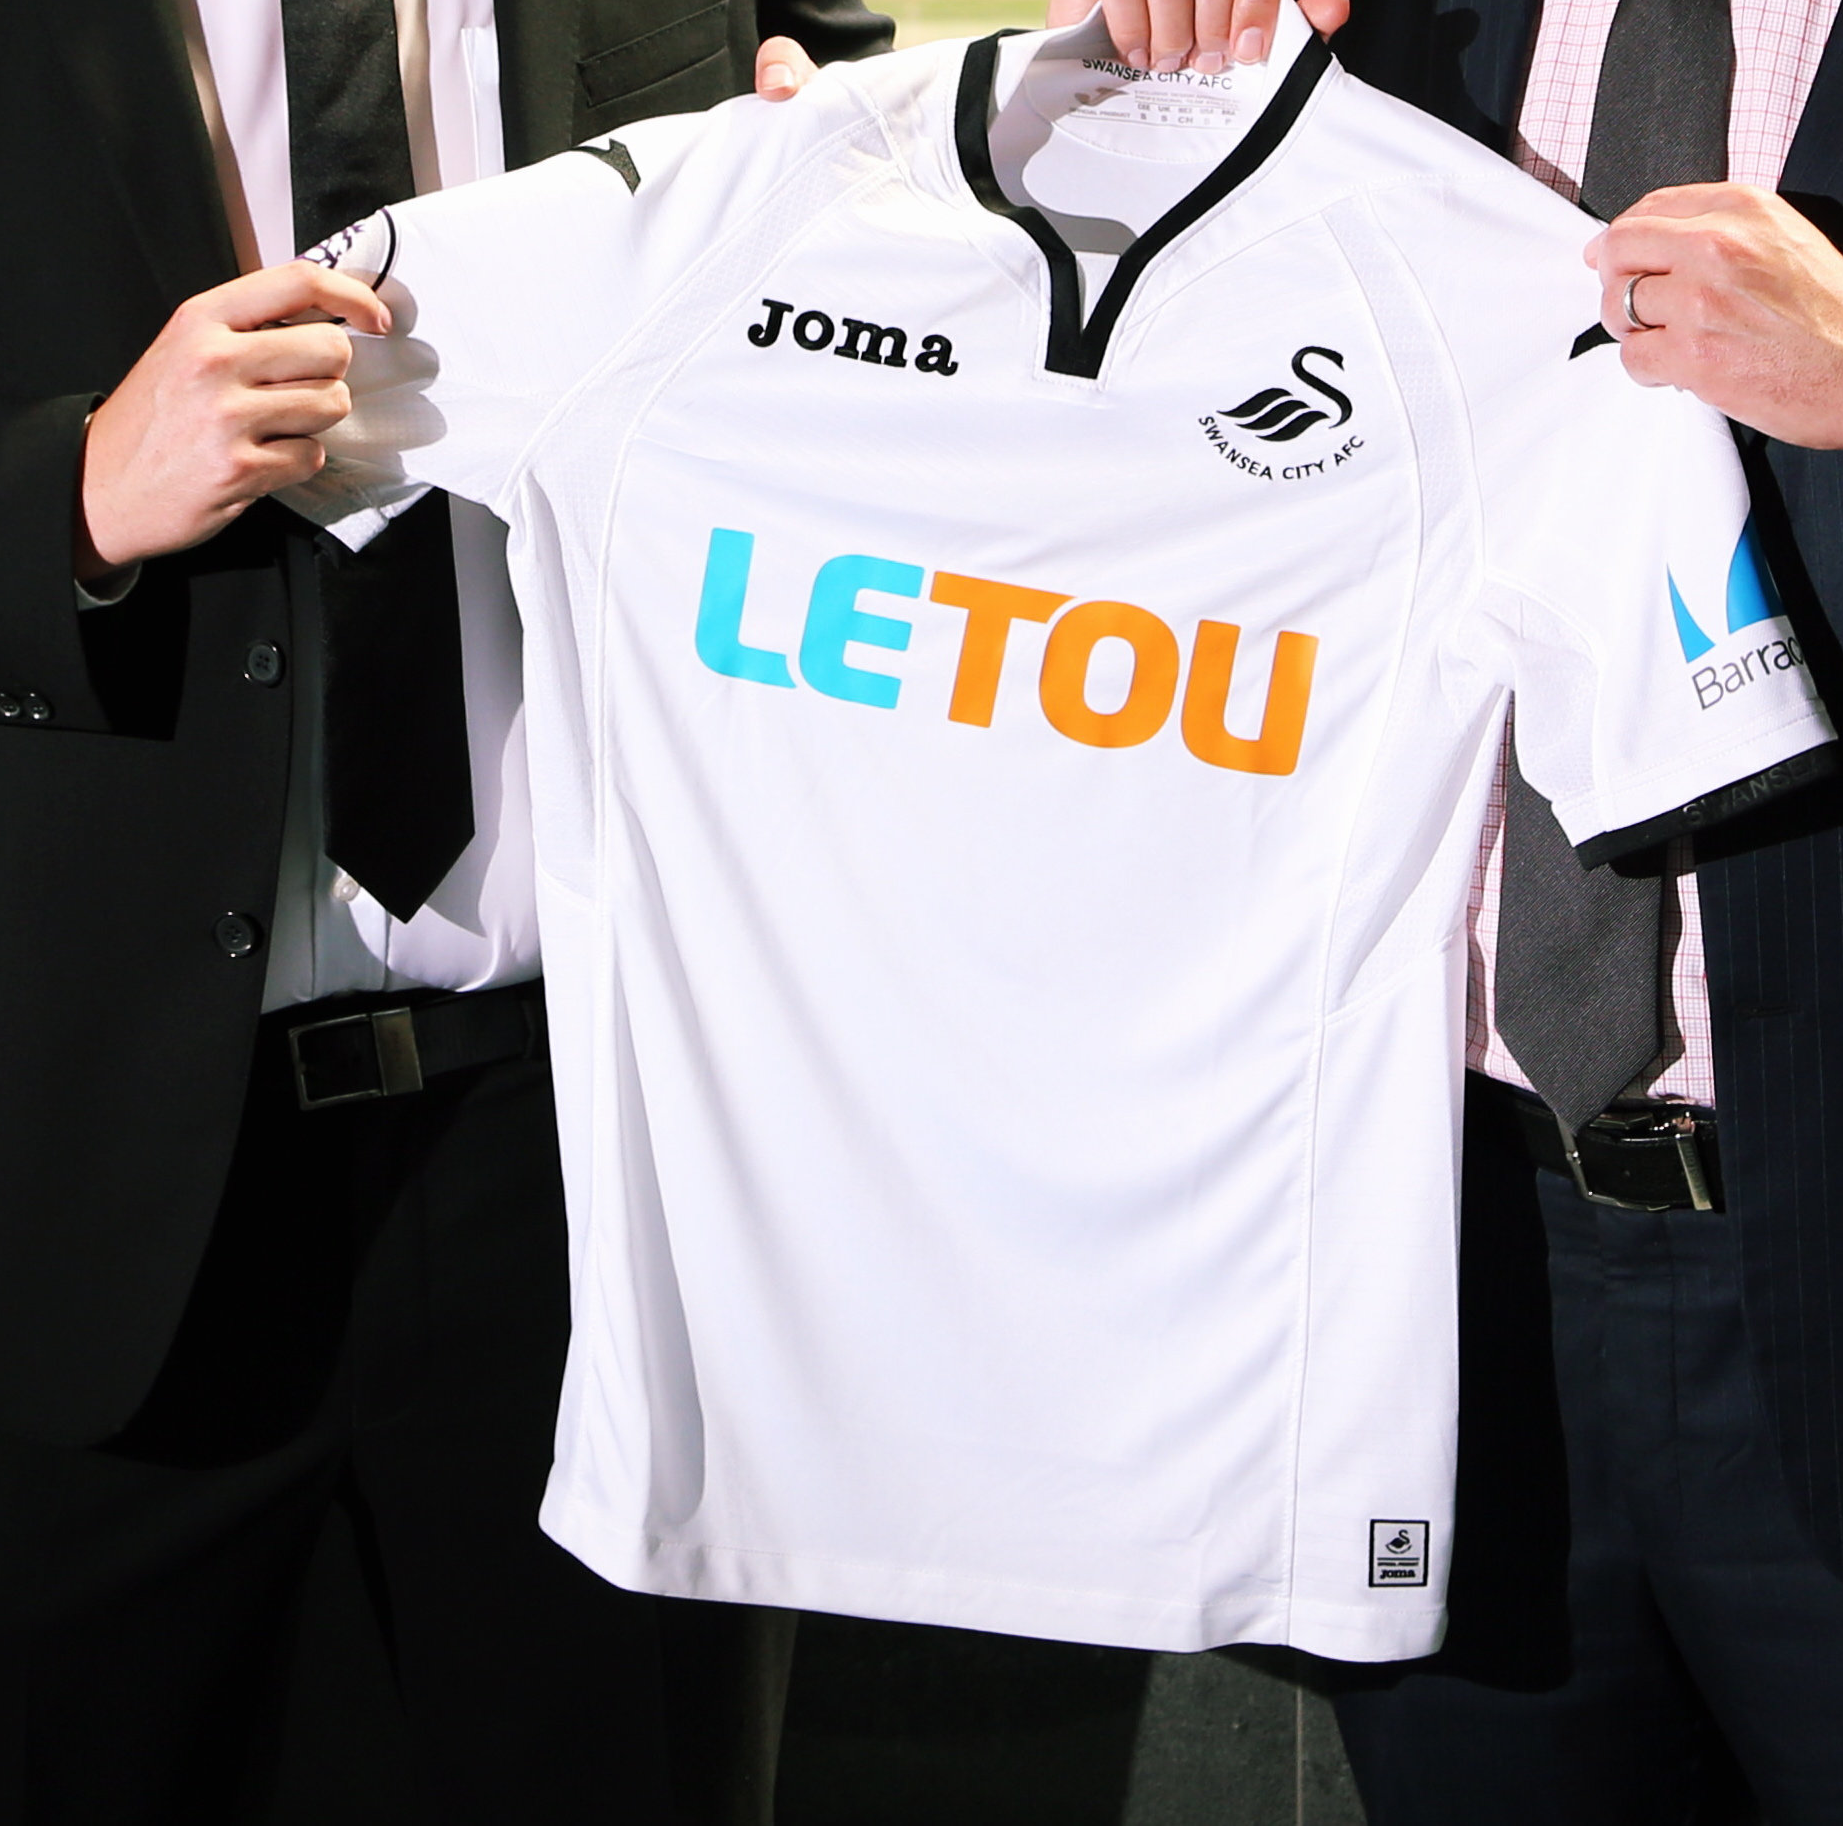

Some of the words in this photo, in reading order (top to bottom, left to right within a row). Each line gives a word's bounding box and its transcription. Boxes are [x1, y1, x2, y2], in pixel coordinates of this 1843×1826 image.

[1082, 58, 1153, 82] SWANSEA
[1157, 71, 1195, 86] CITY
[1199, 76, 1233, 90] AFC
[1198, 415, 1274, 481] SWANSEA
[1282, 458, 1325, 480] CITY
[1333, 434, 1365, 466] AFC
[694, 526, 1319, 776] LETOU
